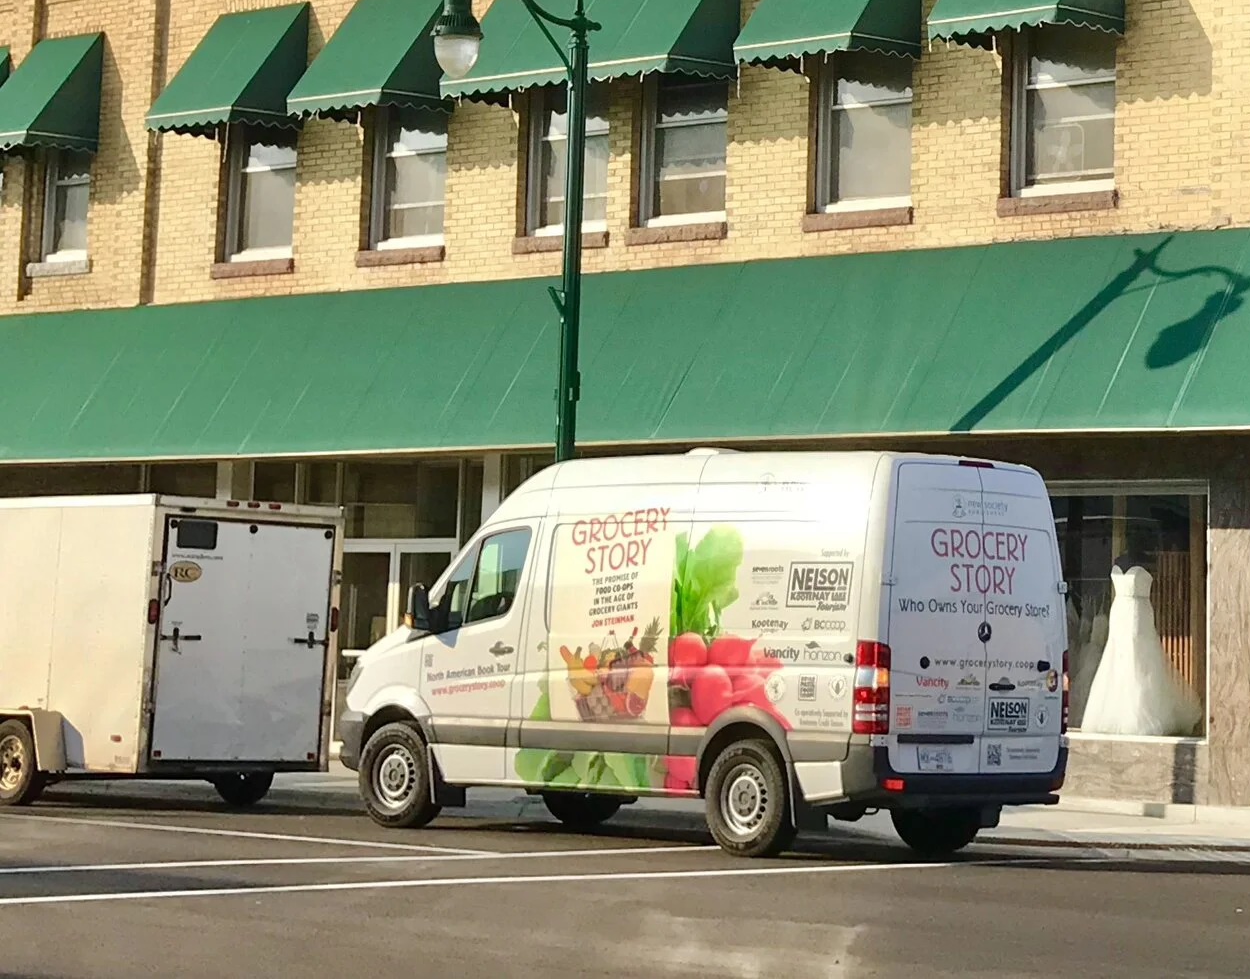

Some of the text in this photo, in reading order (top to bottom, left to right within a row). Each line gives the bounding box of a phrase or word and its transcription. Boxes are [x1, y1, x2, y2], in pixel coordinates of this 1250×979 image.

[571, 507, 671, 546] GROCERY
[930, 528, 1028, 562] GROCERY
[584, 537, 653, 574] STORY
[174, 567, 196, 579] RC
[592, 571, 639, 586] THE PROMISE OF
[791, 567, 850, 591] NELSON
[950, 563, 1016, 595] STORY
[595, 582, 634, 595] FOOD CO-OPS
[593, 592, 635, 606] IN THE AGE OF
[588, 601, 639, 616] GROCERY GIANTS
[898, 598, 1050, 618] Who Owns Your Grocery Store?
[591, 614, 635, 628] JON STEINMAN
[751, 618, 789, 631] Kootenay
[934, 658, 1035, 670] www.grocerystory.coop
[426, 662, 511, 683] North American Book Tour
[916, 675, 950, 689] Vancity
[990, 702, 1028, 719] NELSON
